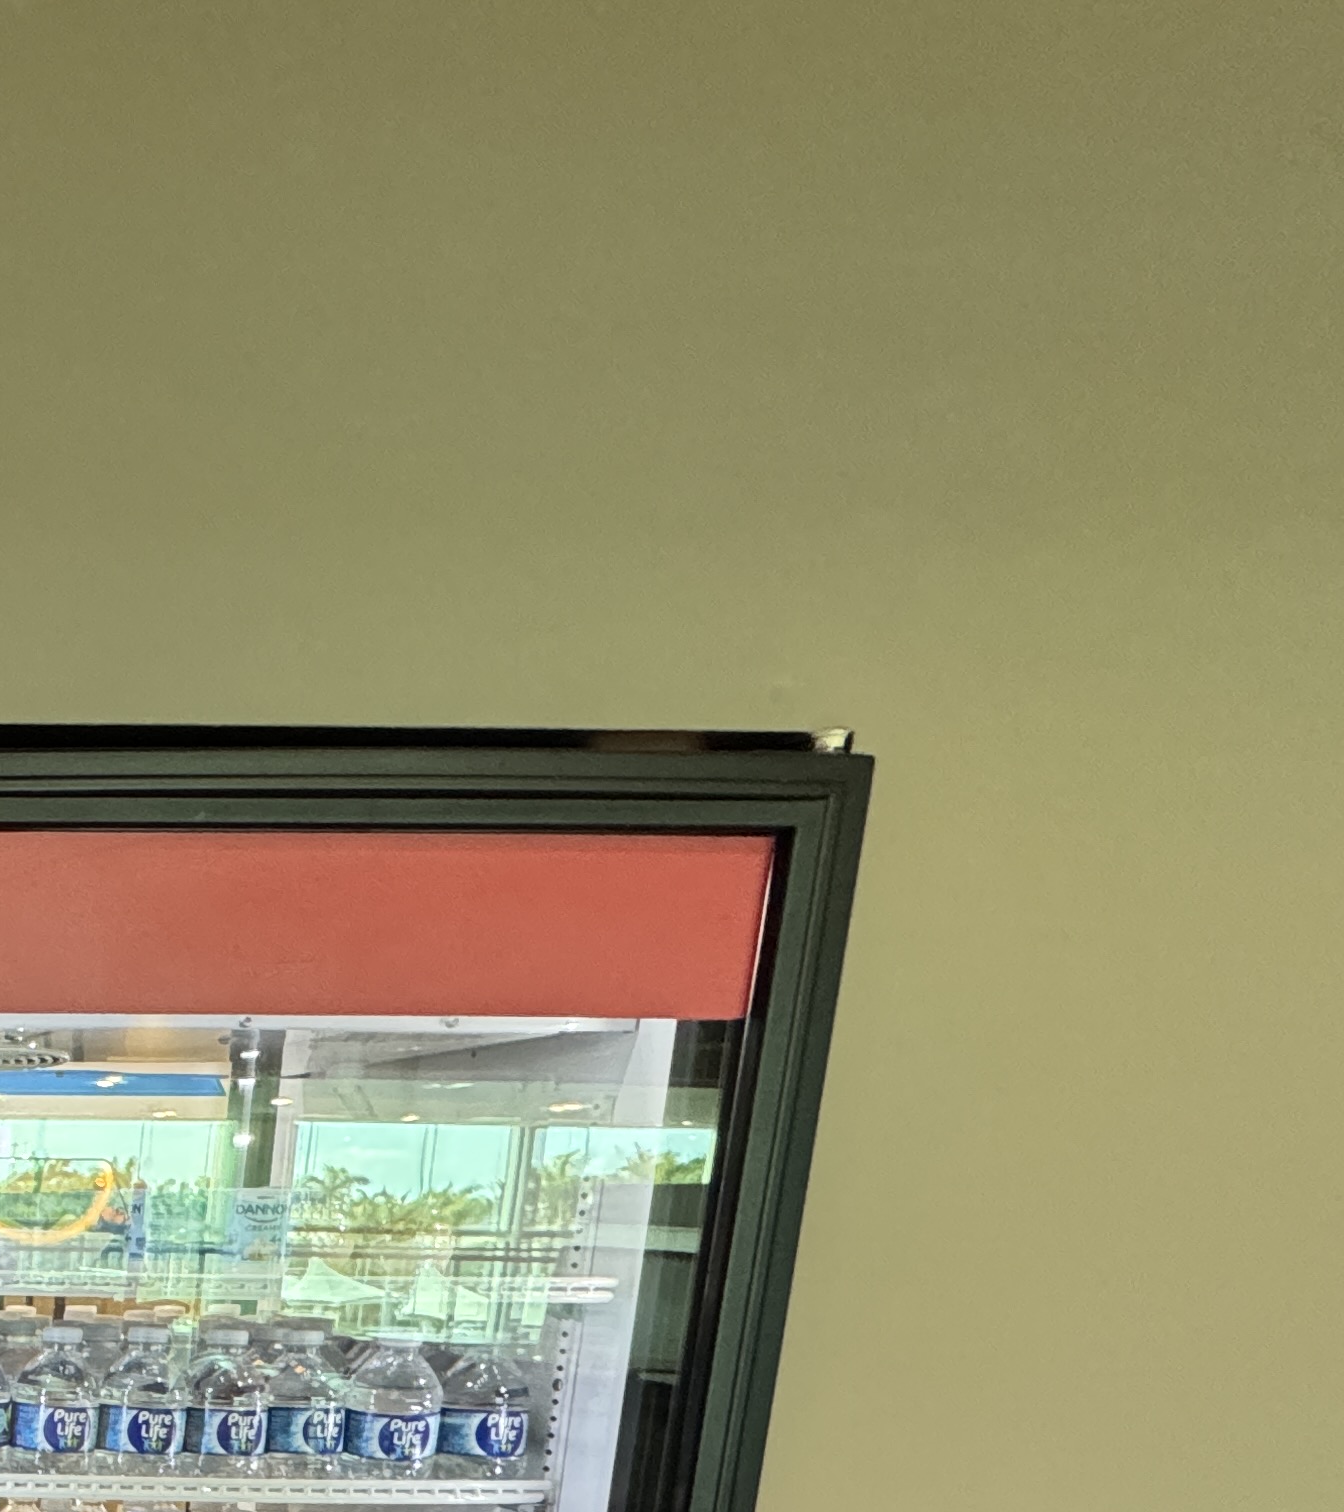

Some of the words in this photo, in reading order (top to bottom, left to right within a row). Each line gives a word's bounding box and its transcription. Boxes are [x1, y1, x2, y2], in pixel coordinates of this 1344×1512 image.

[54, 1409, 88, 1425] Pure
[138, 1411, 173, 1427] Pure
[227, 1411, 261, 1427] Pure
[57, 1423, 83, 1440] Life
[141, 1425, 169, 1442] Life
[230, 1425, 256, 1442] Life
[390, 1418, 426, 1433] Pure
[392, 1431, 423, 1449] Life
